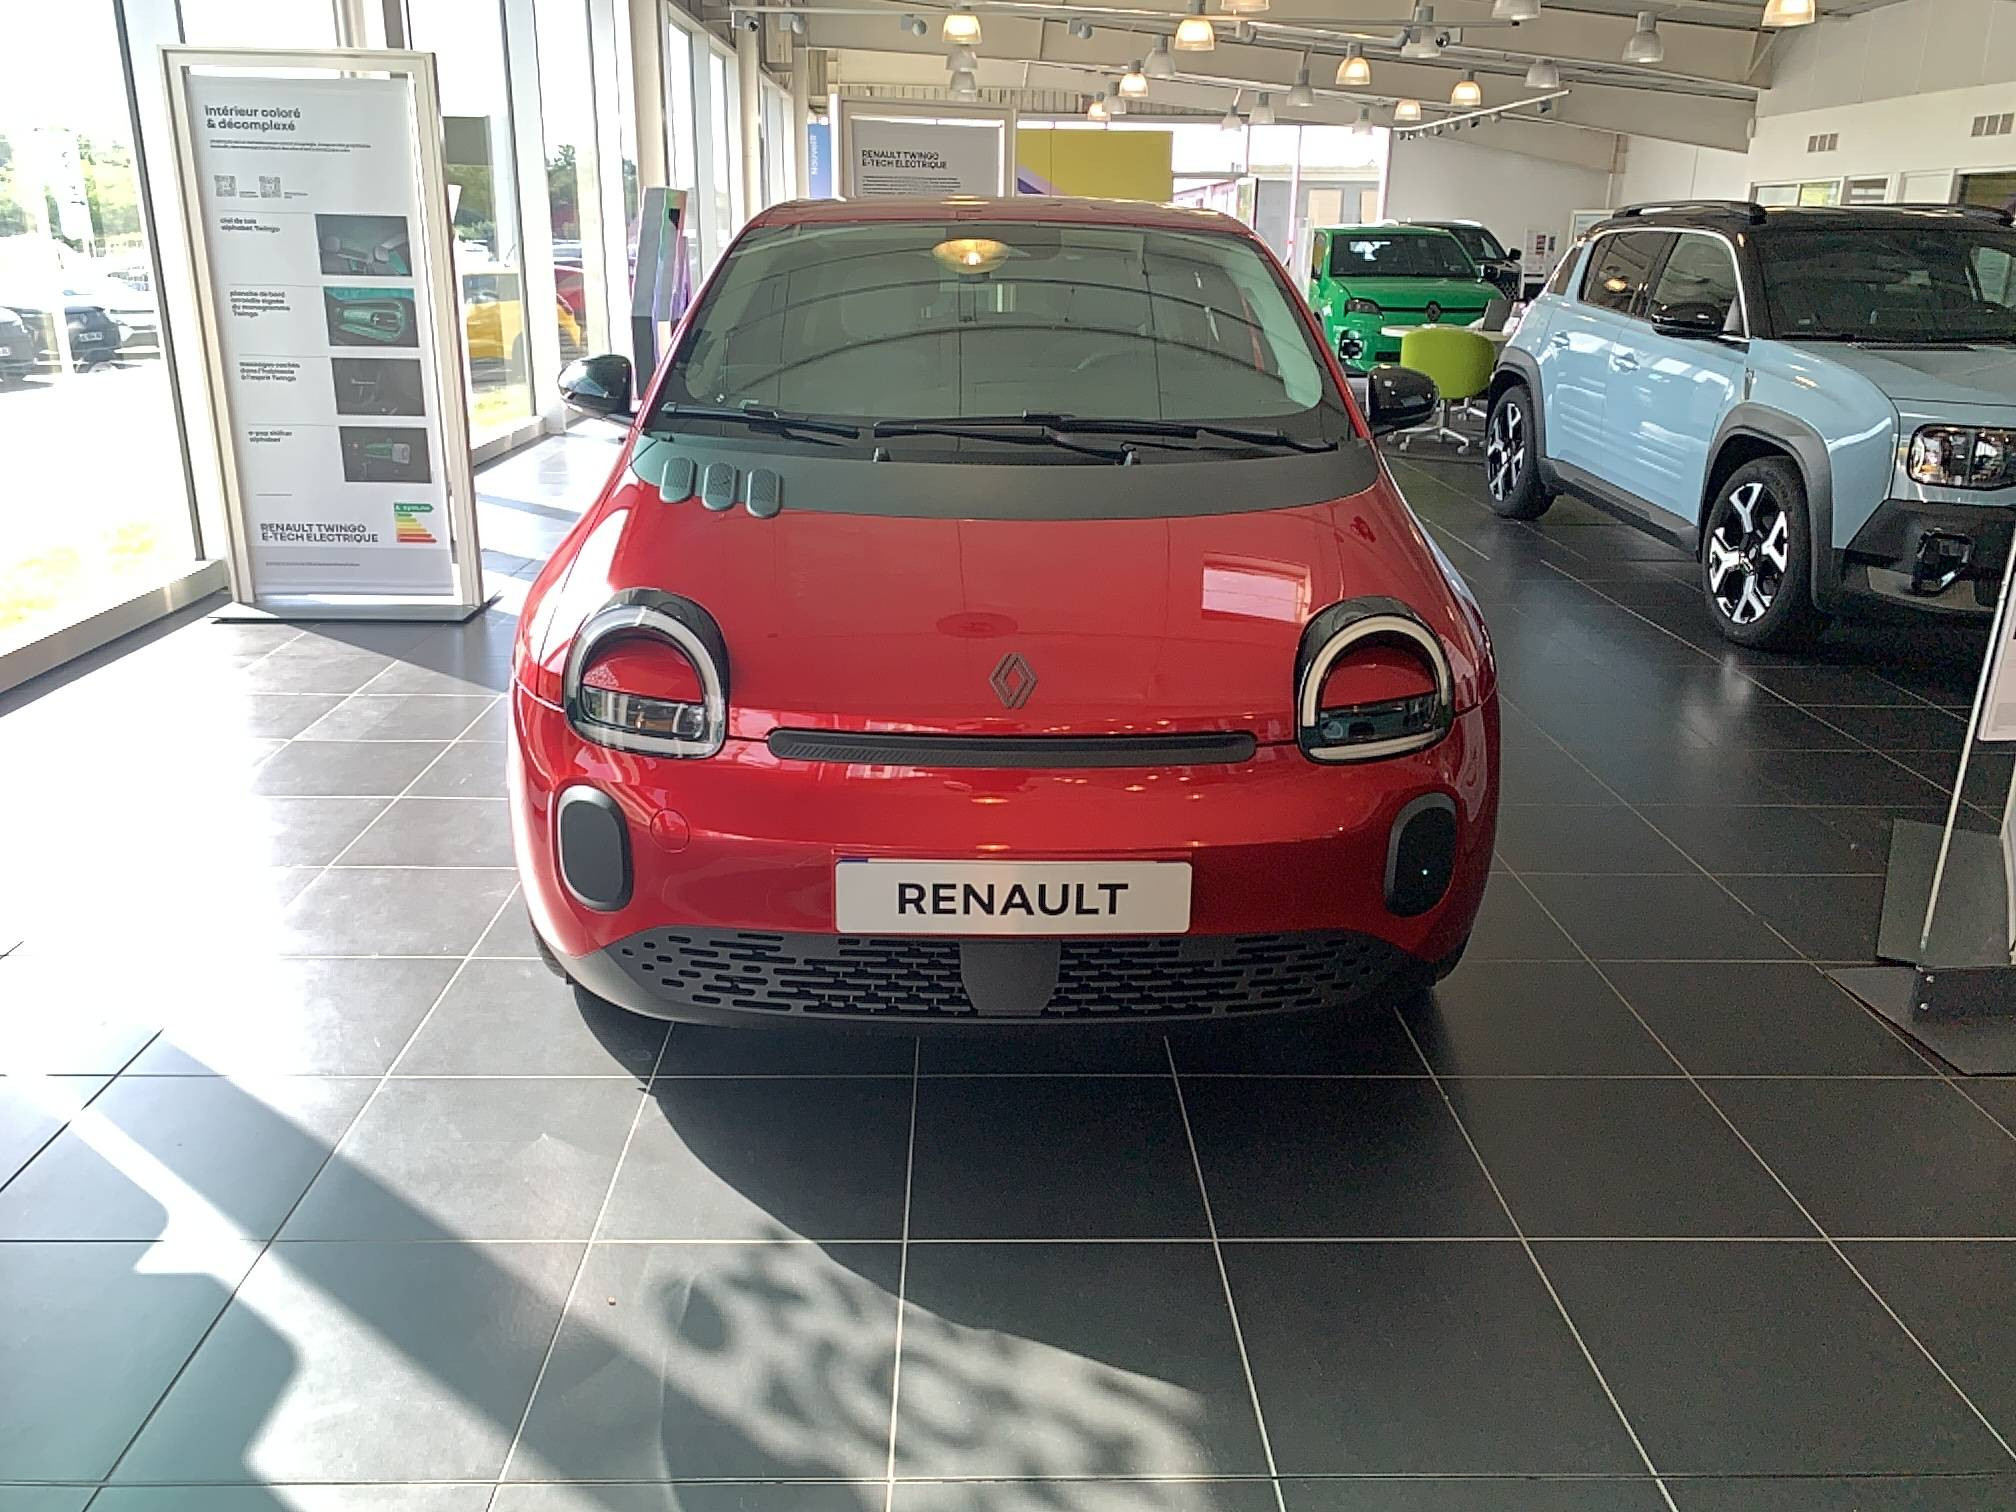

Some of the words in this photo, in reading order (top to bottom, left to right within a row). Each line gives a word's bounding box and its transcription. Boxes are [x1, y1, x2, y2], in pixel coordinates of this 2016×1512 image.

[261, 106, 301, 119] coloré
[207, 118, 217, 129] &
[218, 117, 297, 133] décomplexé
[862, 149, 901, 159] RENAULT
[903, 151, 940, 161] TWINGO
[862, 158, 894, 167] E-TECH
[260, 523, 313, 533] RENAULT
[315, 523, 367, 533] TWINGO
[262, 532, 305, 542] E-TECH
[897, 883, 1129, 916] RENAULT
